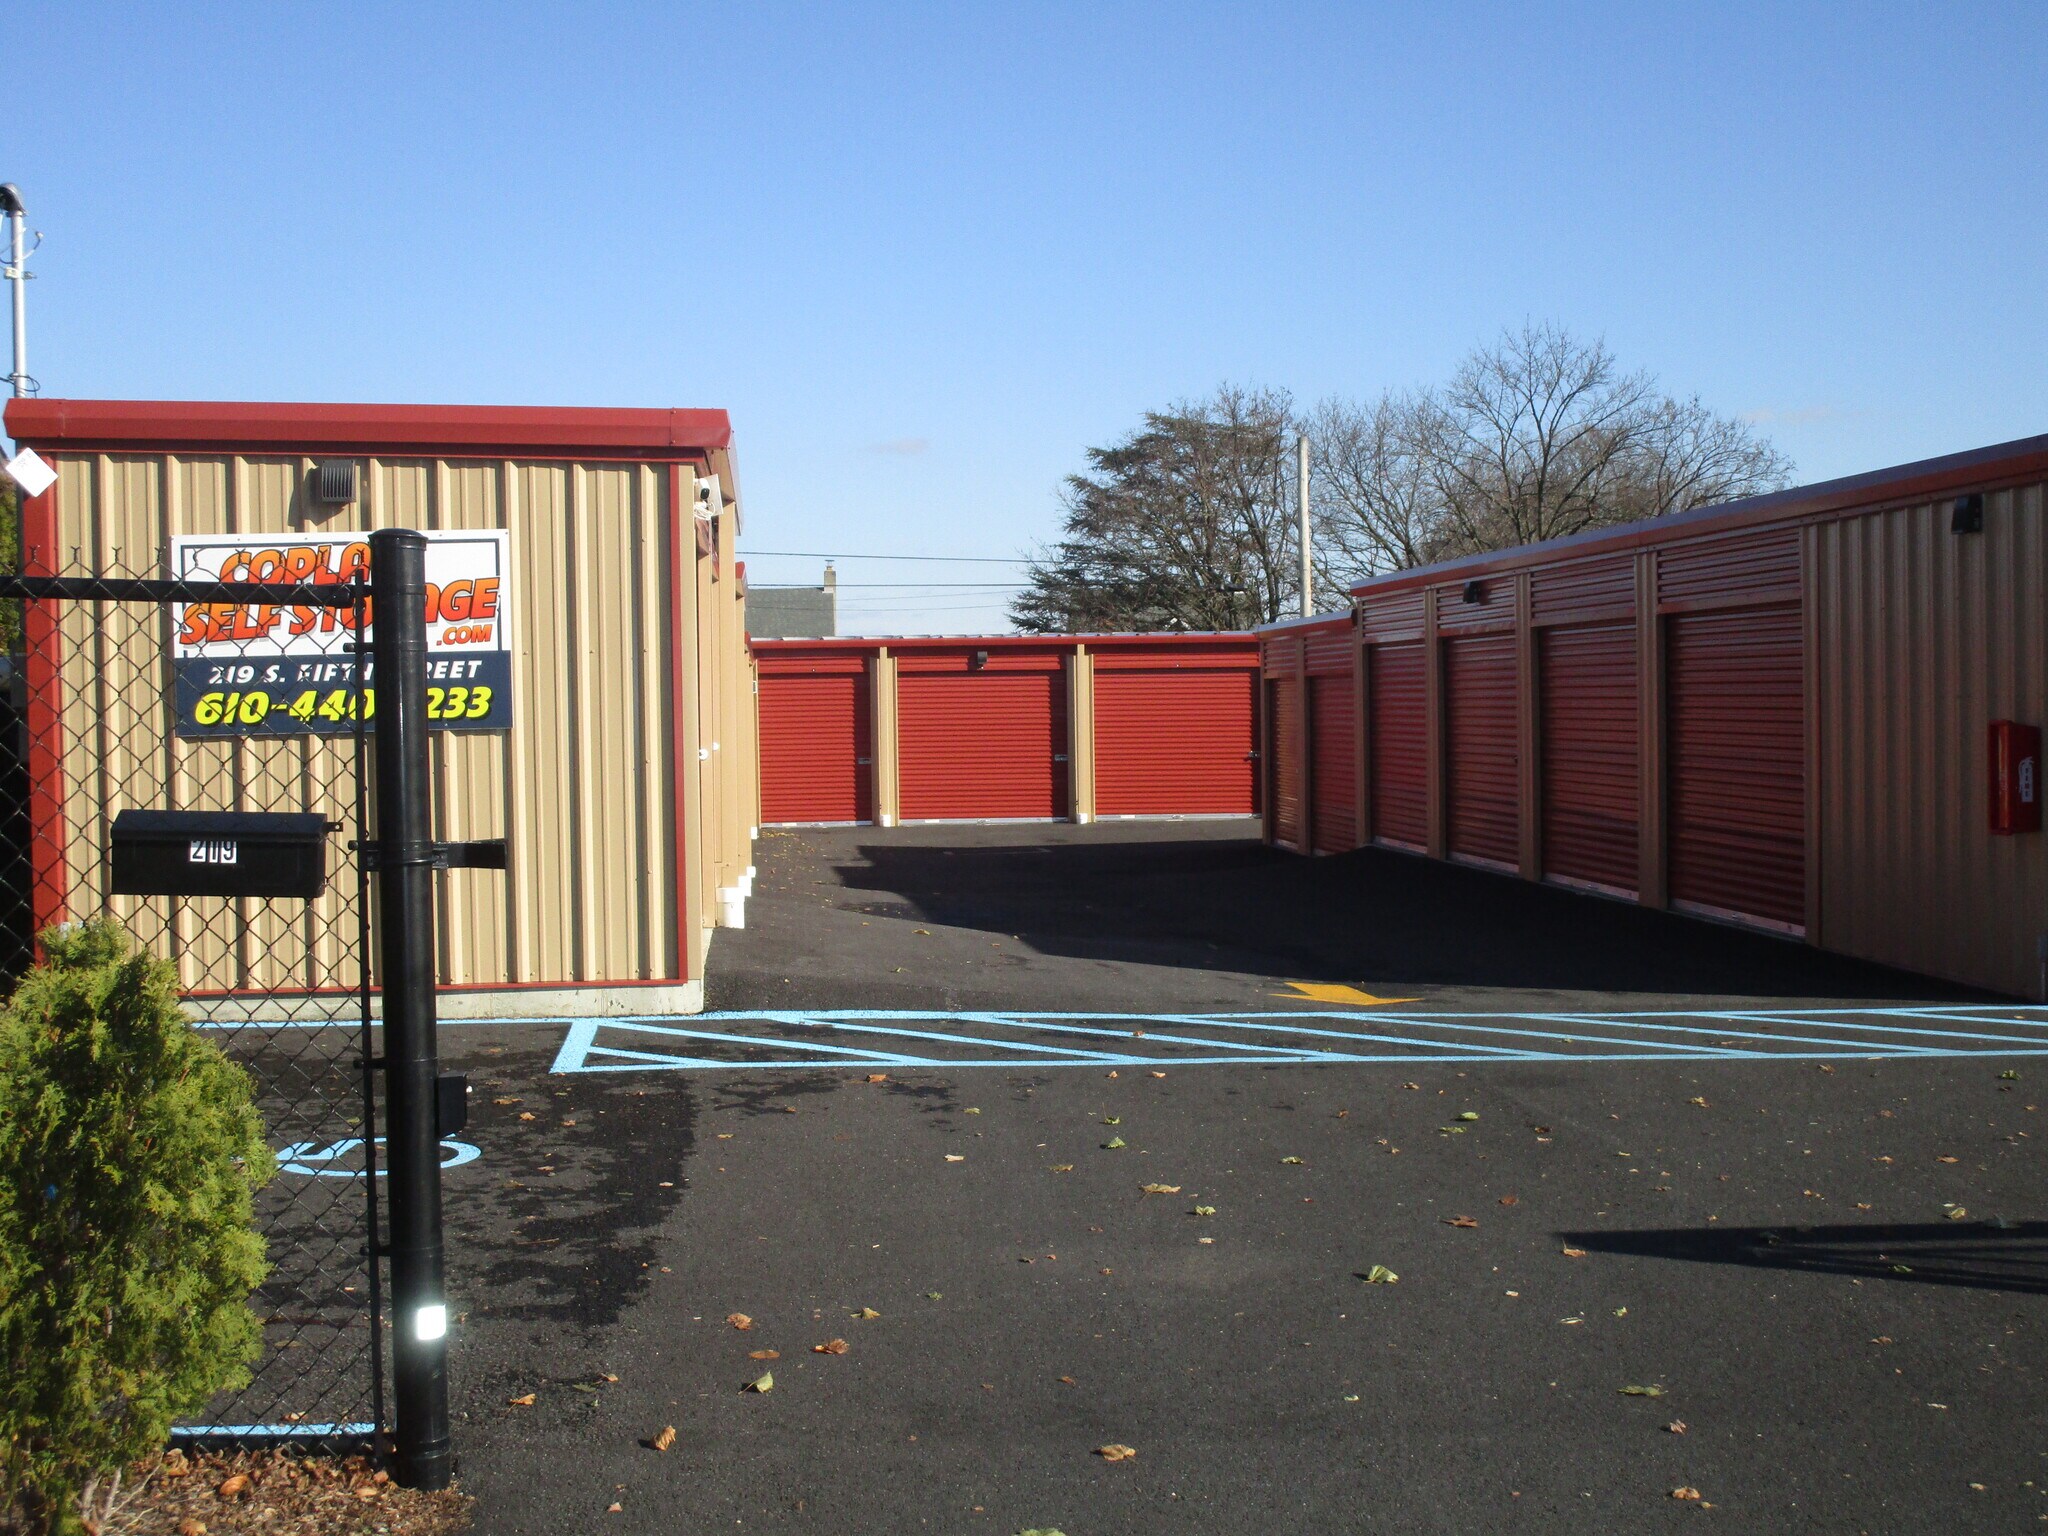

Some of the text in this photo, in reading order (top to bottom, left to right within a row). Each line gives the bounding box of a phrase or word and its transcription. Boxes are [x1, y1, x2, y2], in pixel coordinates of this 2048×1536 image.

[219, 541, 372, 585] COPLA
[179, 576, 500, 645] SELF STOGE
[436, 624, 492, 646] .COM
[208, 664, 255, 684] 219
[262, 664, 286, 683] S.
[194, 686, 493, 726] 610-440233
[191, 840, 234, 861] 219
